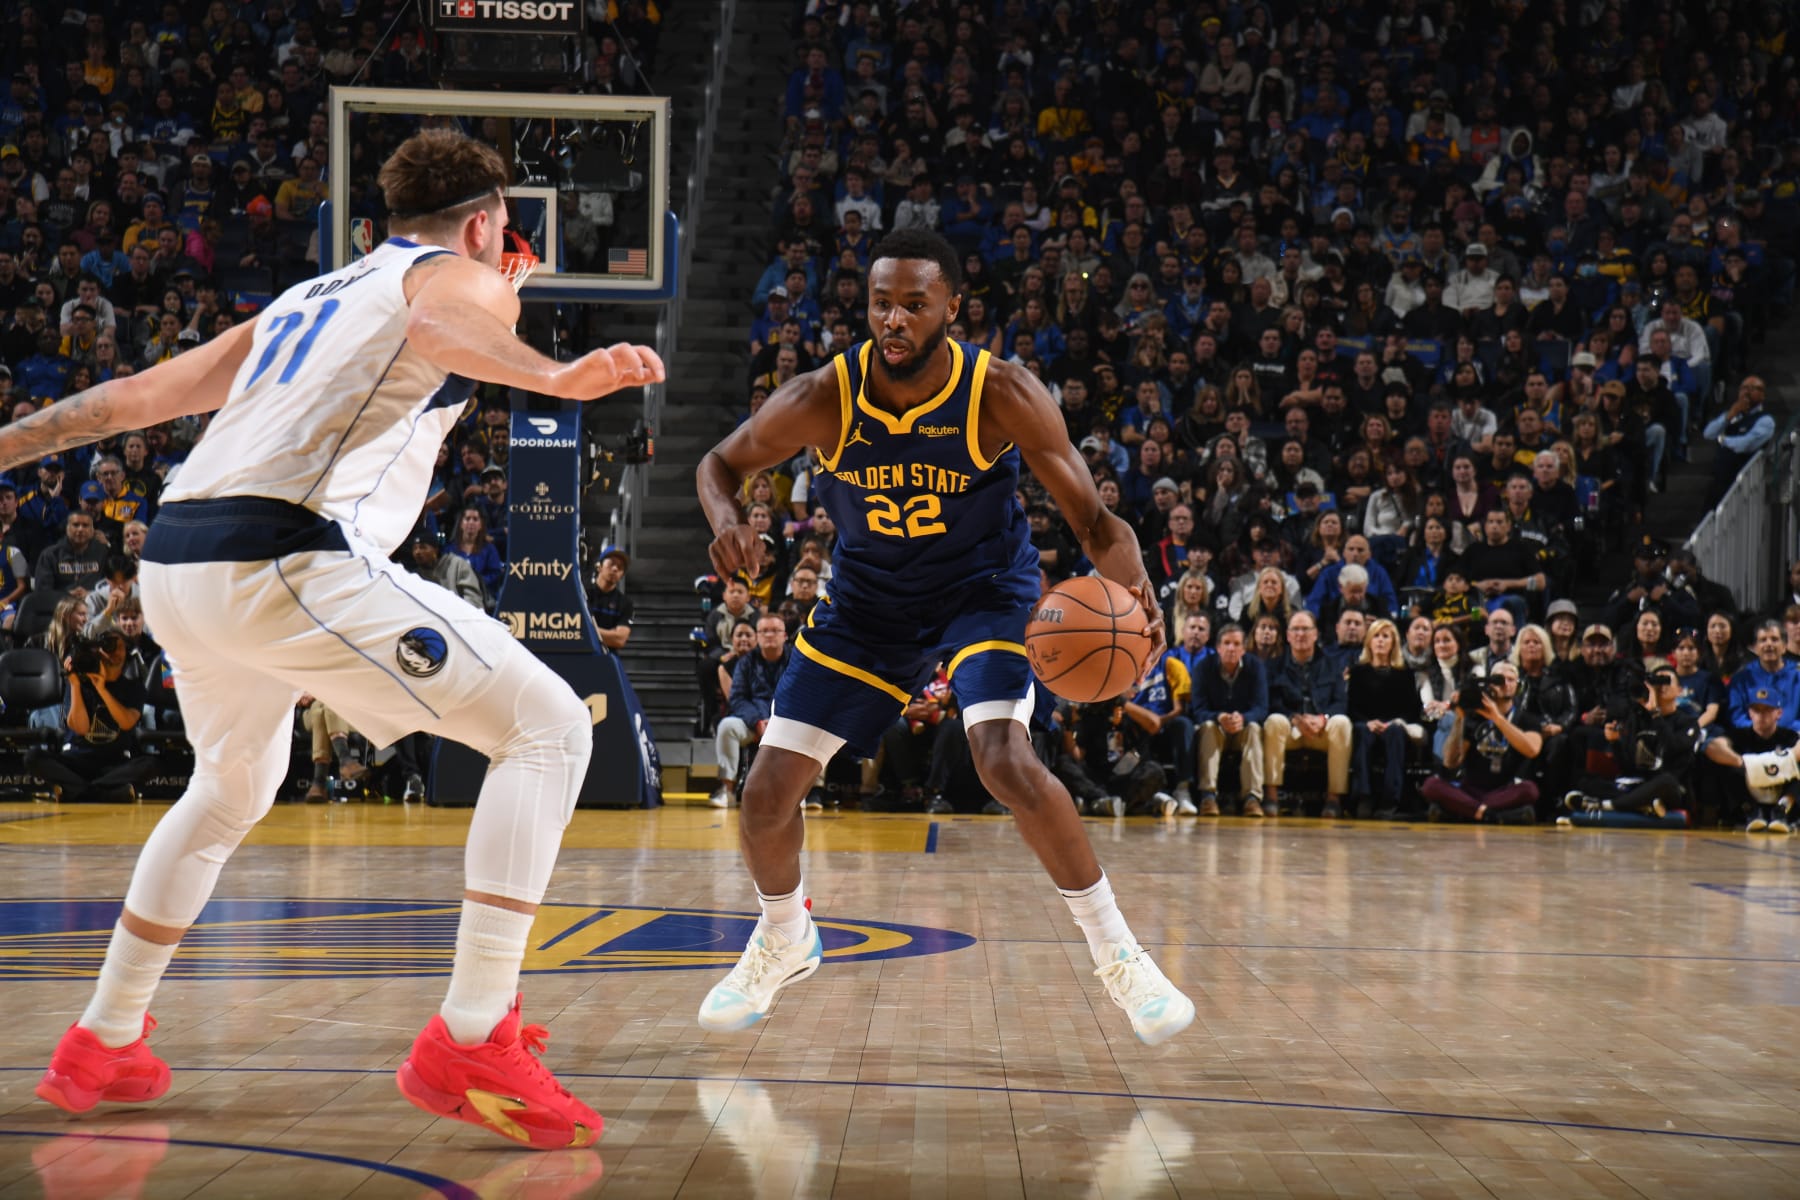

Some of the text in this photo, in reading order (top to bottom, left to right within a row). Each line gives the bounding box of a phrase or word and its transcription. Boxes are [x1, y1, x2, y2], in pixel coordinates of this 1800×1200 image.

[477, 1, 574, 21] TISSOT
[918, 425, 959, 436] Rakuten
[510, 438, 577, 448] DOORDASH
[834, 463, 972, 494] GOLDEN STATE
[863, 493, 947, 538] 22
[509, 556, 574, 581] xfinity
[529, 612, 581, 630] MGM
[529, 630, 581, 640] REWARDS
